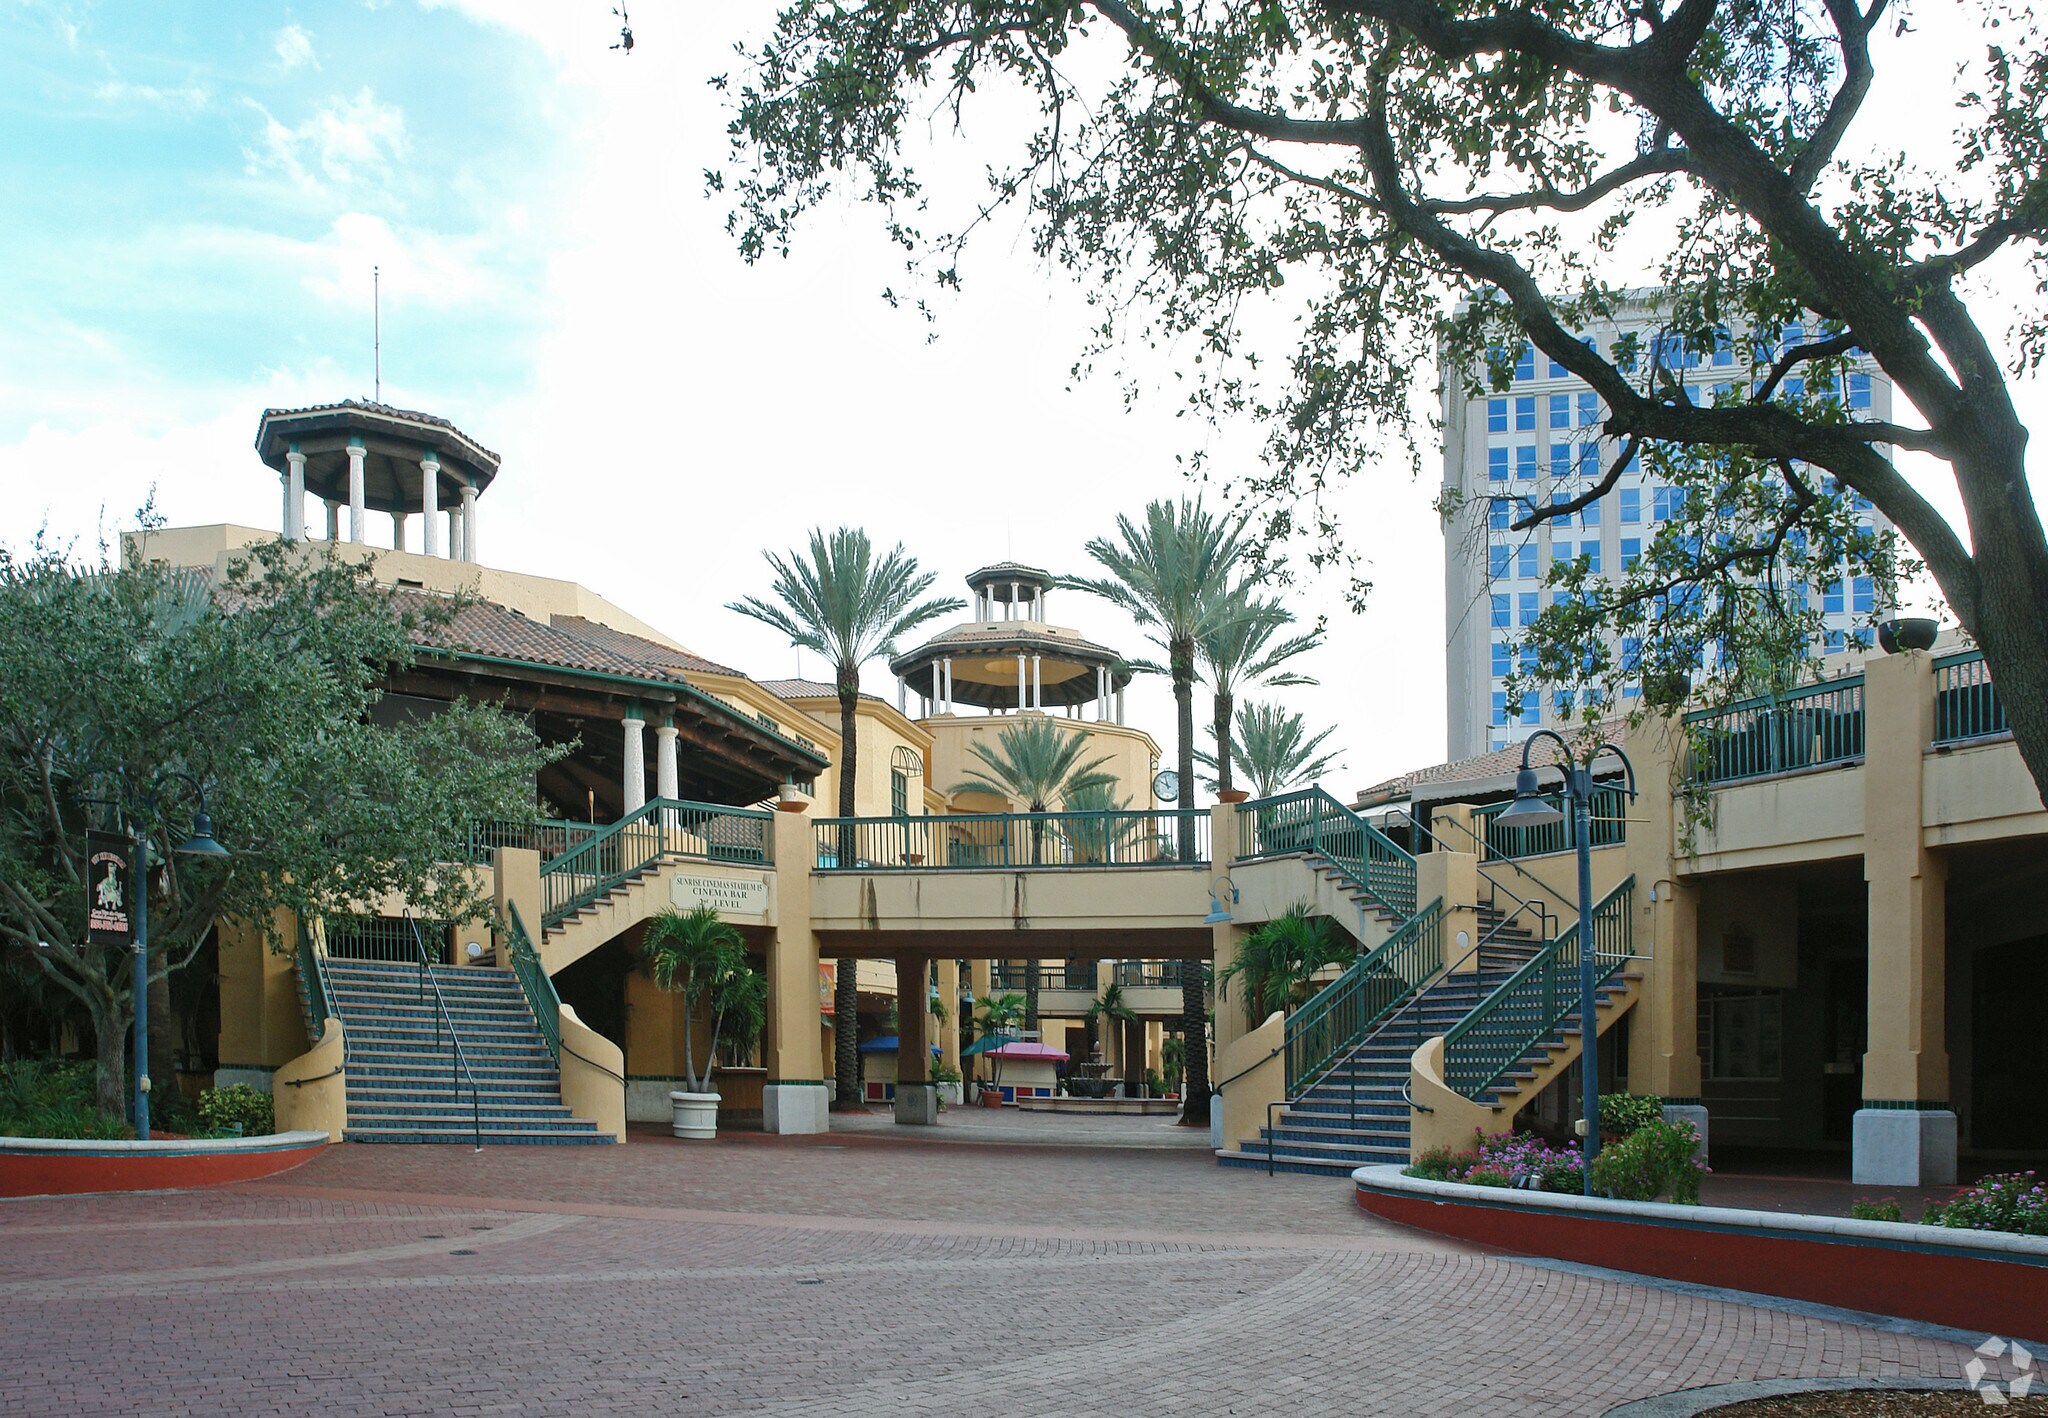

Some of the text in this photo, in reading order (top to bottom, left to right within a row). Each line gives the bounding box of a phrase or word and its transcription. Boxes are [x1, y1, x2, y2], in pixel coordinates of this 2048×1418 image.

[676, 877, 701, 887] SUNRISE
[702, 879, 730, 889] CINEMAS
[730, 881, 757, 891] STADIUM
[692, 887, 748, 899] CINEMA BAR
[714, 899, 742, 909] LEVEL
